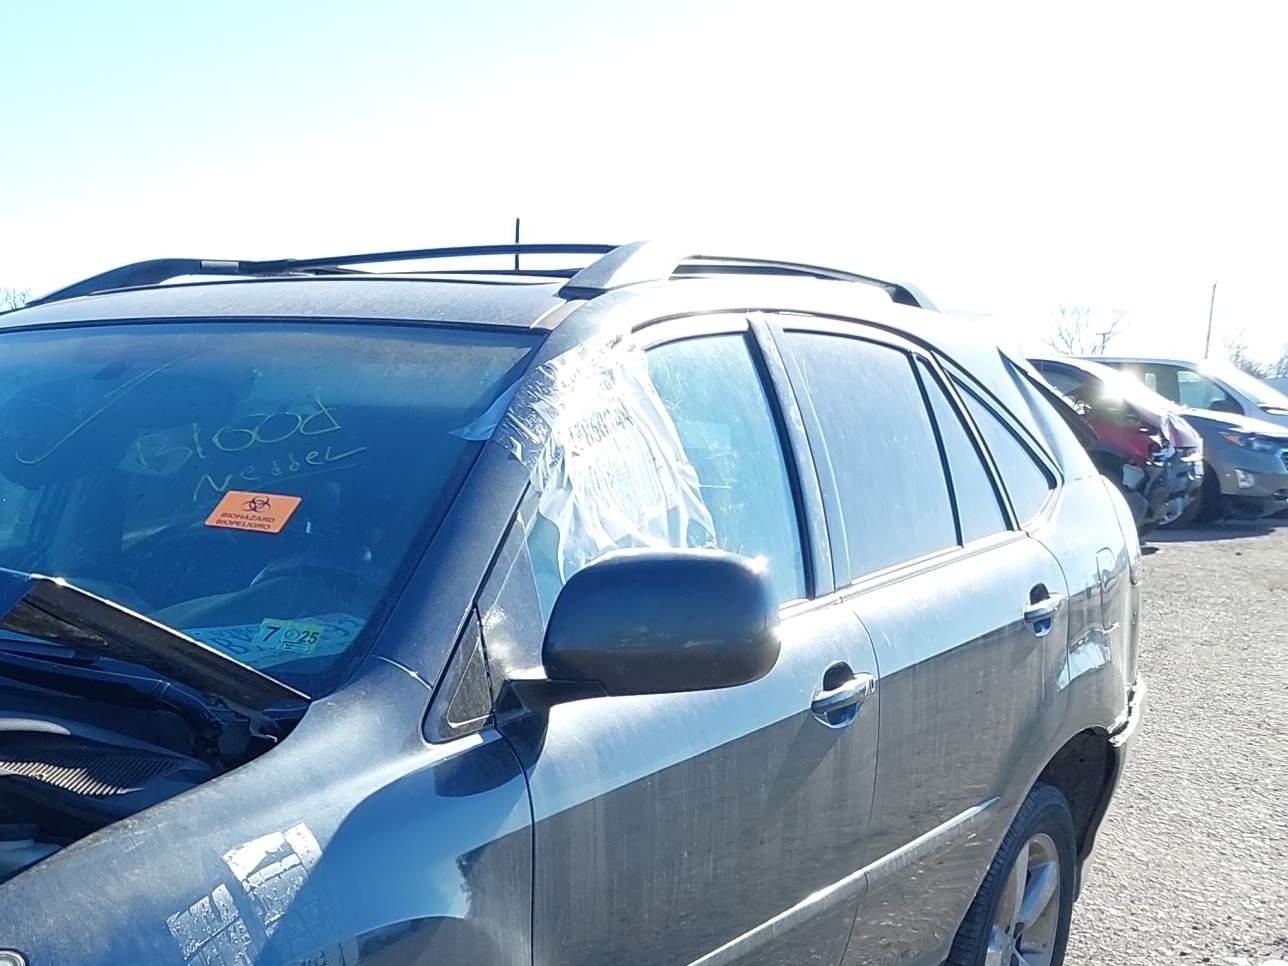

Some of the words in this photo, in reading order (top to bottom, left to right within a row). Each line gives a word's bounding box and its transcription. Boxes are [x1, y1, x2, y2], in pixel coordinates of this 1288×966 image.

[220, 512, 276, 522] BIOHAZARD
[215, 519, 271, 530] BIOPELIGRO
[262, 626, 280, 642] 7
[298, 630, 320, 645] 25
